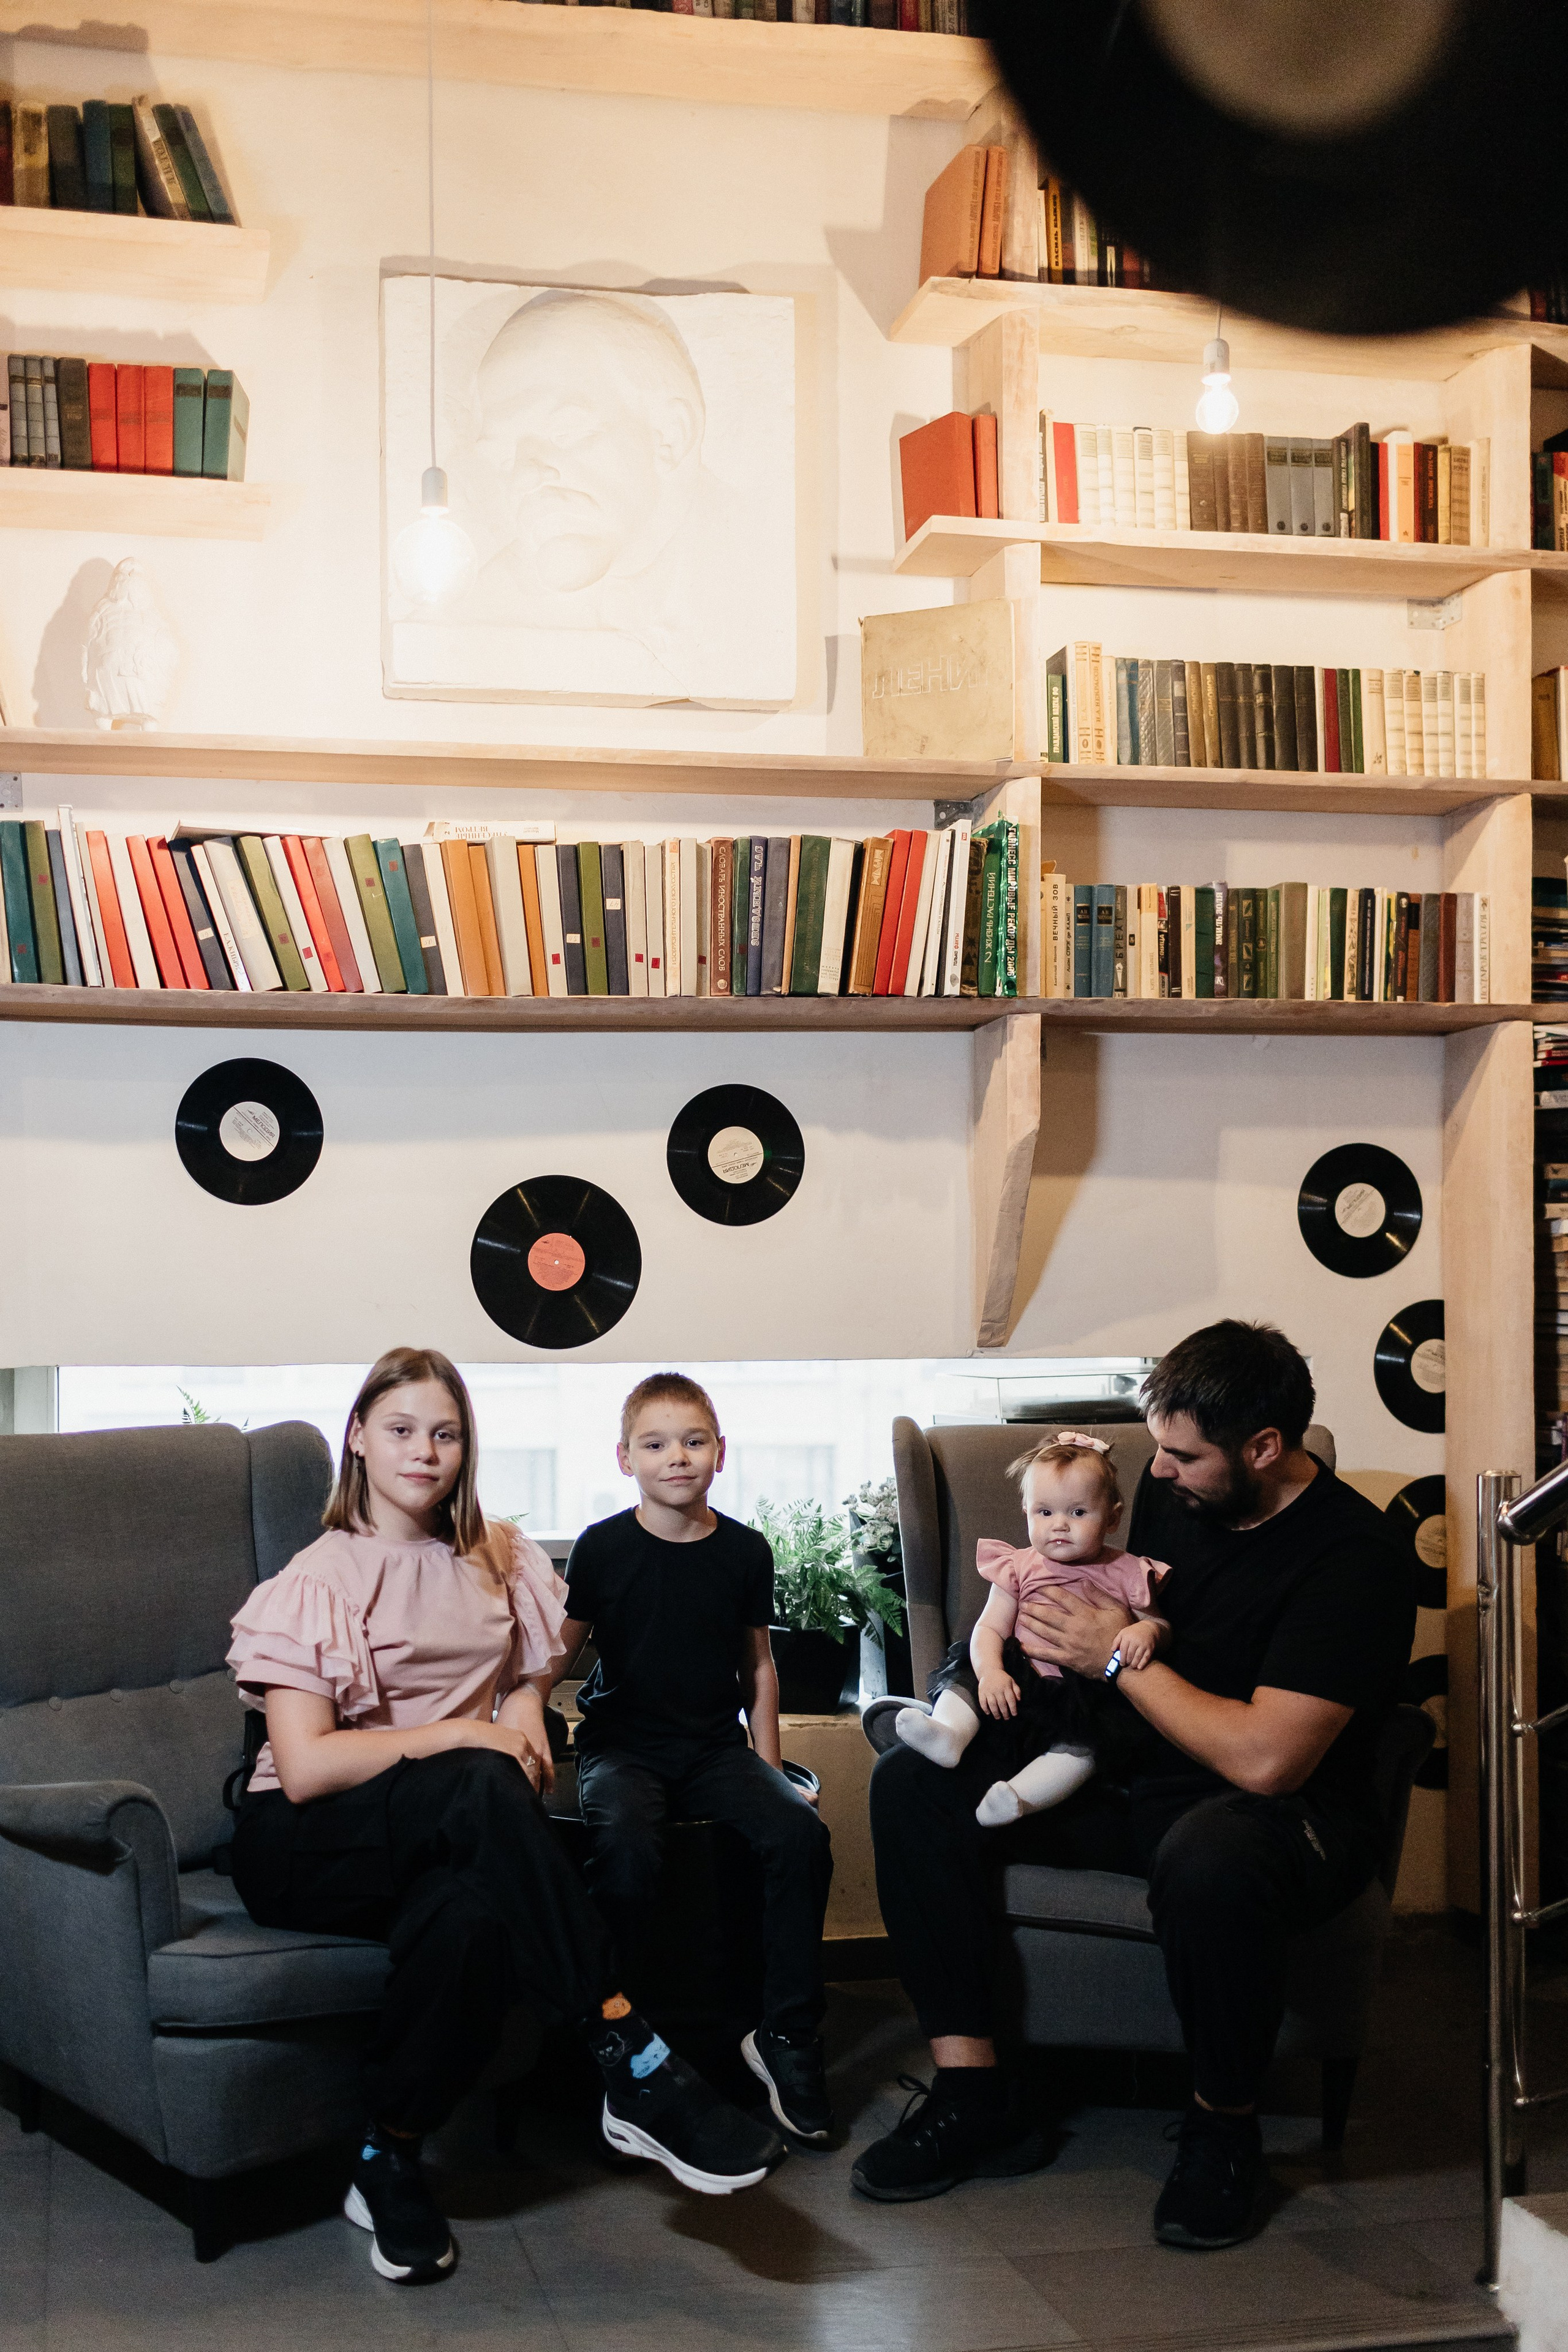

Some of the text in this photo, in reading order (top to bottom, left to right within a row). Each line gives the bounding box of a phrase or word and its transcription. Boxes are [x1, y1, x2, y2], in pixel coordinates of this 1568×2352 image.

[1052, 687, 1058, 695] РФ
[750, 846, 763, 946] ЗВЕЗДНЫЙ ЧАС
[1008, 867, 1017, 910] МИРОВЫЕ
[984, 872, 997, 963] 2 ЖИЗНЬ РАСТЕНИЙ
[1008, 912, 1018, 954] РЕКОРДЫ
[252, 1115, 276, 1139] МЕЛОДИЯ
[722, 1162, 750, 1174] МЕЛОДИЯ
